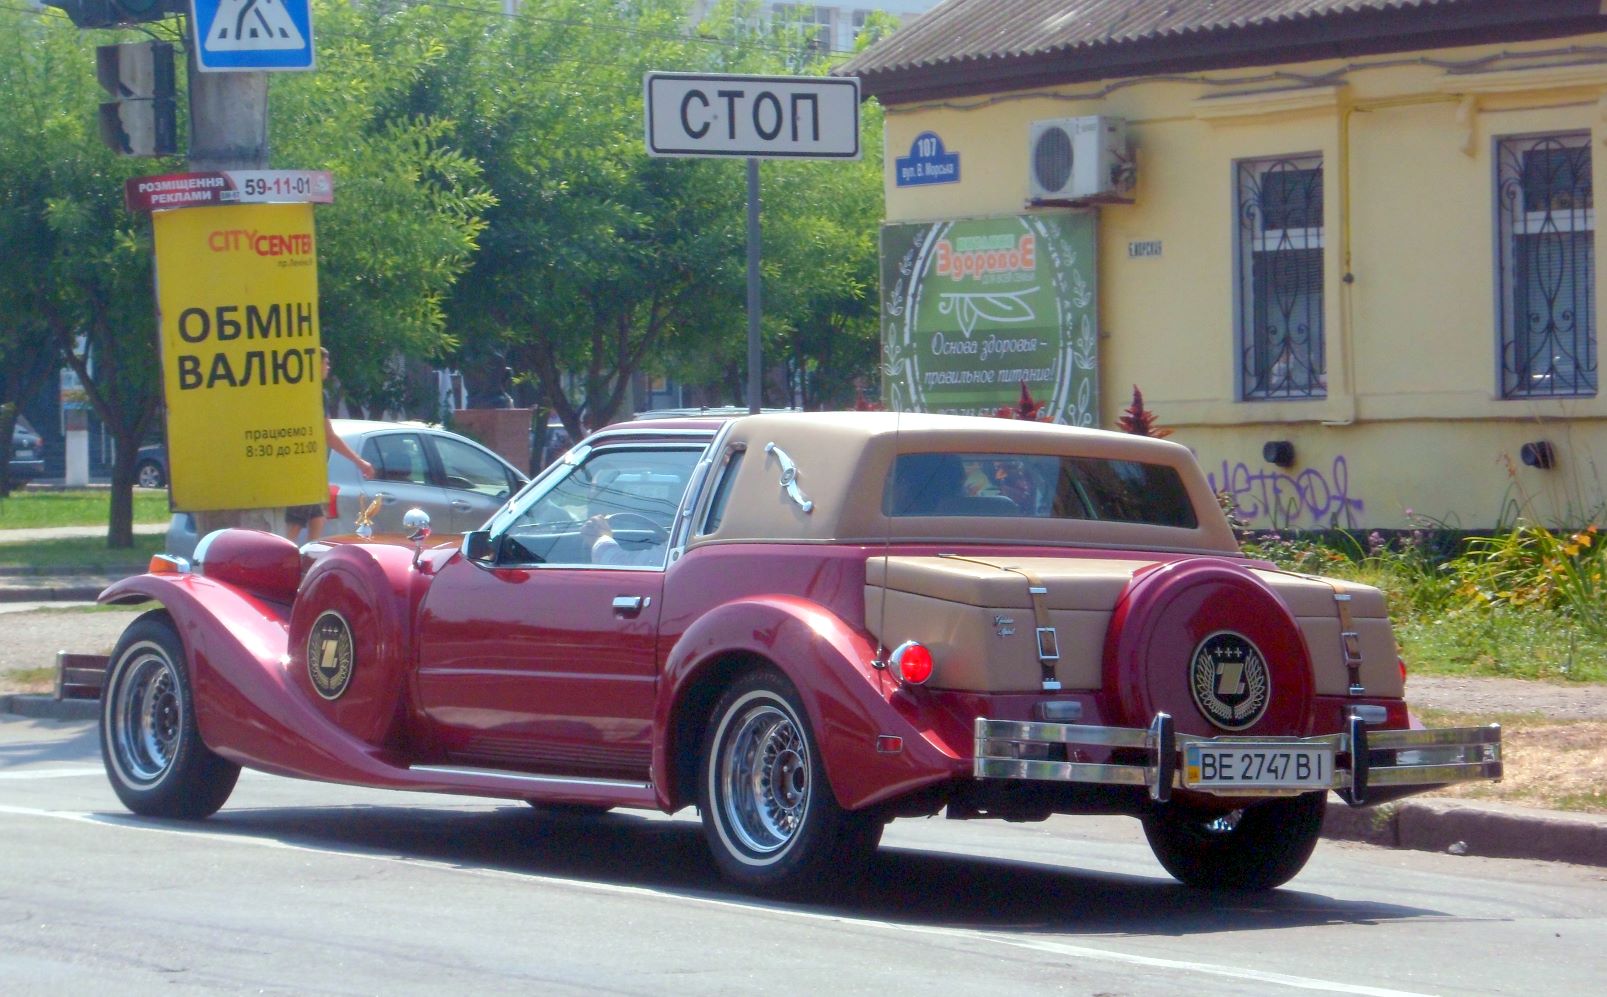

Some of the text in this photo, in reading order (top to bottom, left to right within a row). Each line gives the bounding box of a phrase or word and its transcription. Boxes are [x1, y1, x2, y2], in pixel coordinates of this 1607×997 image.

[680, 89, 820, 141] СТОП
[918, 138, 937, 157] 107
[138, 177, 224, 193] РОЗМІЩЕННЯ
[245, 177, 311, 196] 59-11-01
[151, 191, 212, 204] РЕКЛАМИ
[177, 302, 313, 343] ОБМІН
[931, 332, 978, 356] Основа
[980, 334, 1037, 361] здоровья
[178, 347, 315, 390] ВАЛЮТ
[924, 357, 1057, 391] правильное питание!
[245, 426, 306, 442] працюємо
[246, 440, 318, 458] 8:30 до 21:00
[1202, 753, 1322, 780] BE 2747 BI
